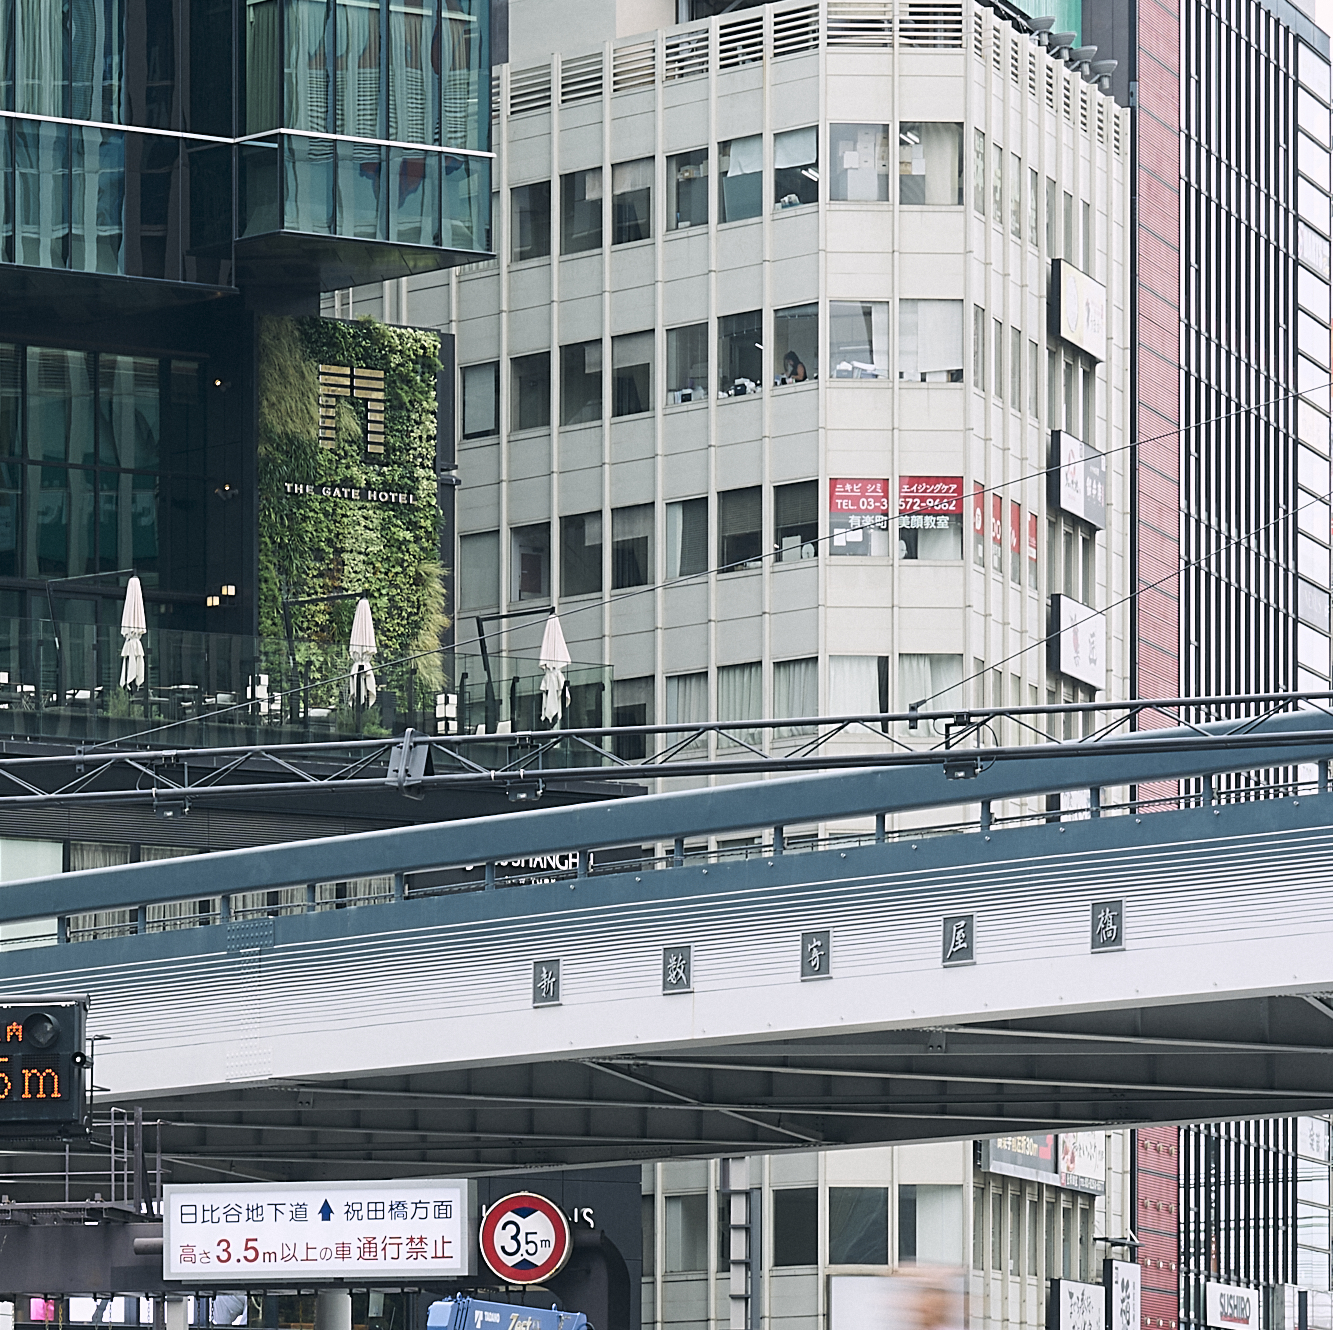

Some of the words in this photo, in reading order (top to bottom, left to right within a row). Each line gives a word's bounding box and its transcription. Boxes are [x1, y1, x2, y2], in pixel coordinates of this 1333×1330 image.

[284, 482, 314, 495] THE
[322, 486, 360, 500] GATE
[368, 490, 418, 505] HOTEL
[835, 483, 861, 493] ニキビ
[866, 483, 883, 493] シミ
[901, 483, 958, 493] エイジングケア
[836, 499, 857, 510] TEL.
[179, 1201, 310, 1225] 日比谷地下道
[343, 1199, 454, 1222] 祝田橋方面
[500, 1219, 551, 1257] 3.5m
[1219, 1292, 1252, 1320] SUSHIRO
